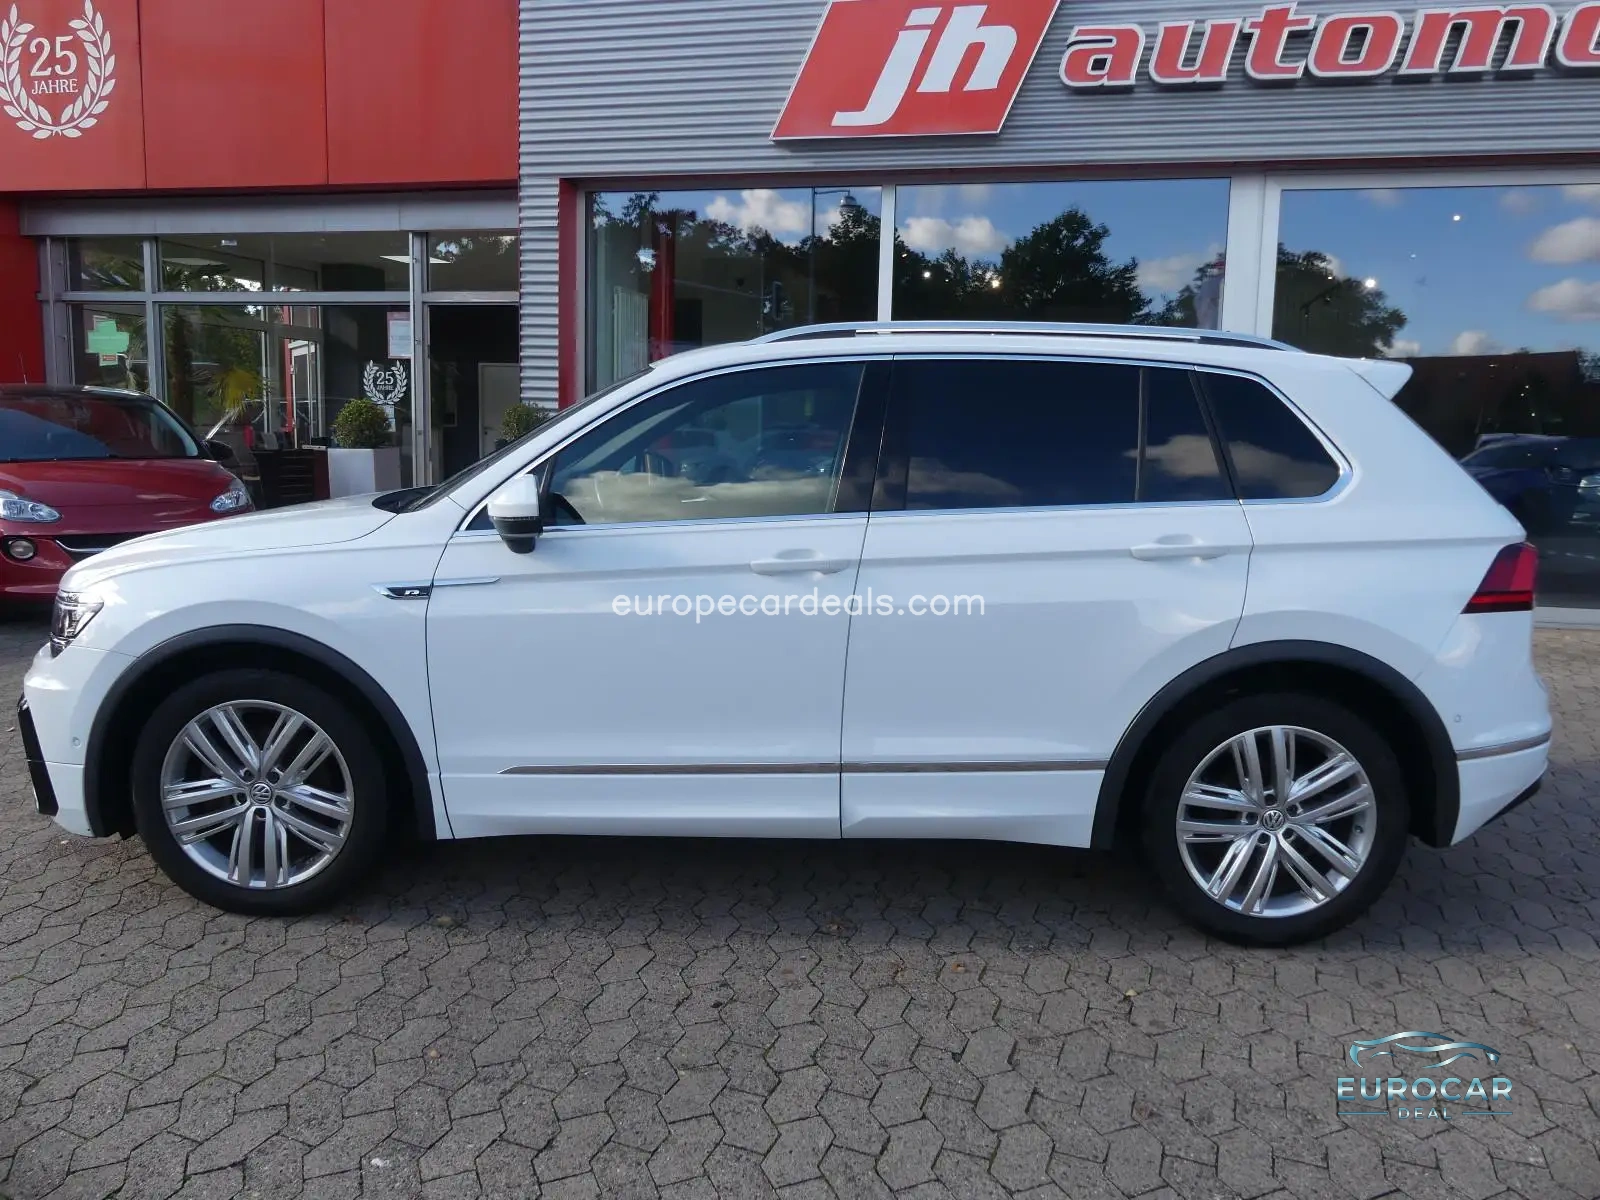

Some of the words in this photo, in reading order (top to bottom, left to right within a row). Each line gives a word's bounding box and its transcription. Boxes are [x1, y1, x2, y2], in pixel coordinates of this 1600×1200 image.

[29, 35, 78, 77] 25
[831, 4, 1018, 127] jh
[31, 78, 79, 95] JAHRE
[376, 371, 394, 385] 25
